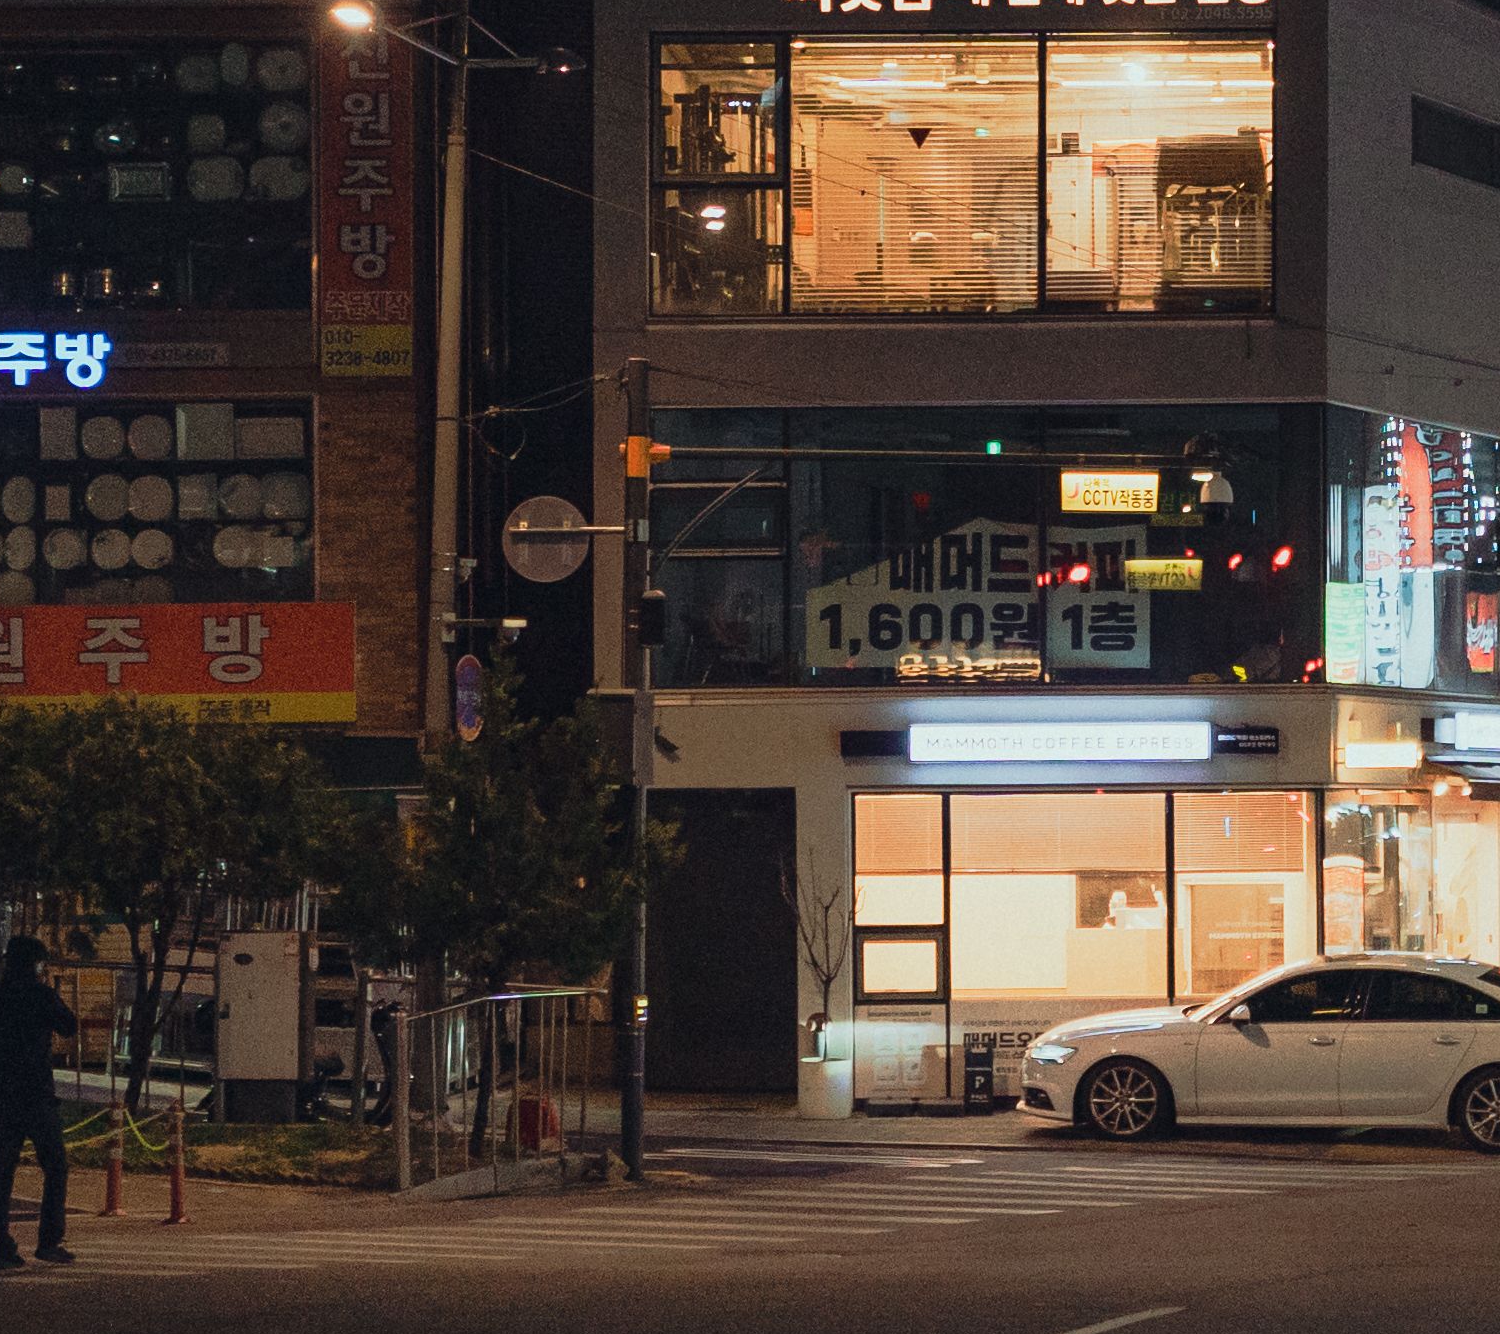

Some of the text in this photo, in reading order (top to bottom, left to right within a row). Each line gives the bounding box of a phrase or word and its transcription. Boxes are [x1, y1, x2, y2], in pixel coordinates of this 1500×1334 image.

[1083, 488, 1155, 509] CCTV작동중
[889, 530, 1033, 595] 매머드
[819, 601, 1139, 657] 1,600원 1층
[925, 736, 1195, 750] MAMMOTH COFFEE EXPRESS
